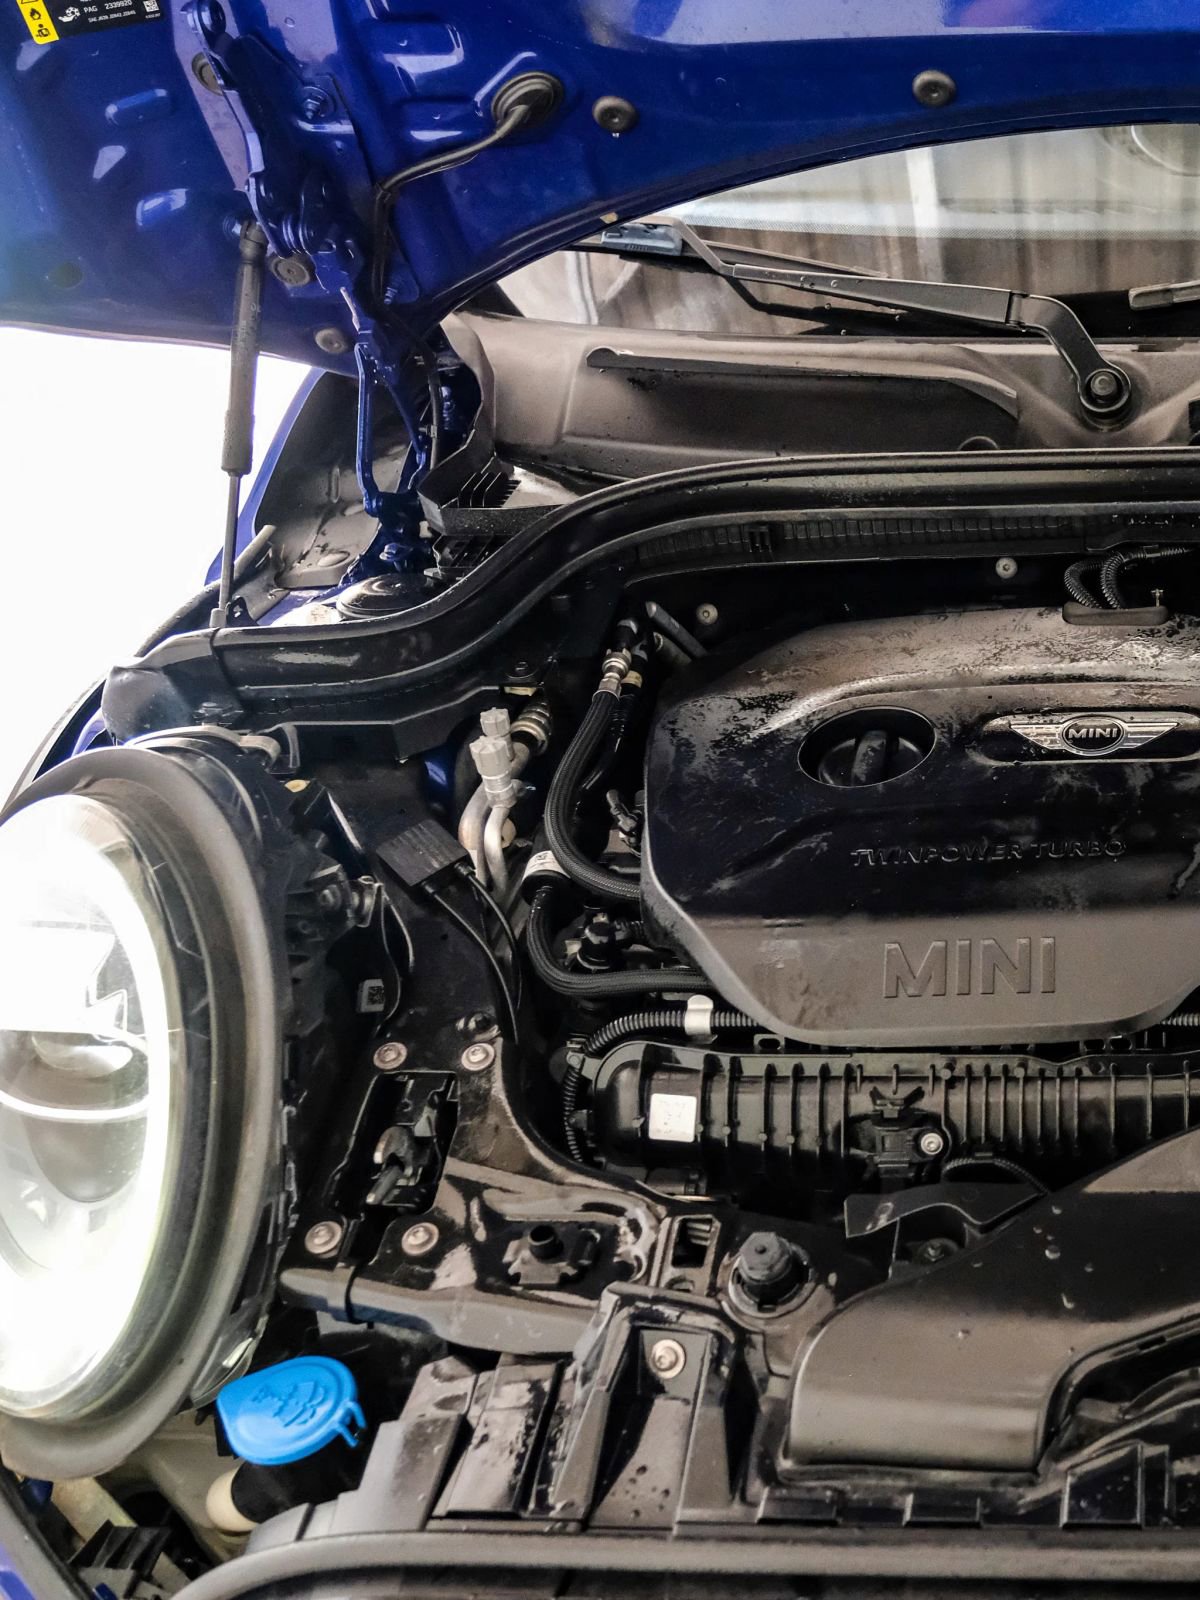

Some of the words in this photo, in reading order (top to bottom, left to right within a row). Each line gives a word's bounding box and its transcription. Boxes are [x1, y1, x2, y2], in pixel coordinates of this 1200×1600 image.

[1068, 727, 1118, 739] MINI
[850, 844, 1022, 866] TWINPOWER
[1030, 838, 1126, 858] TURBO
[884, 936, 1056, 999] MINI
